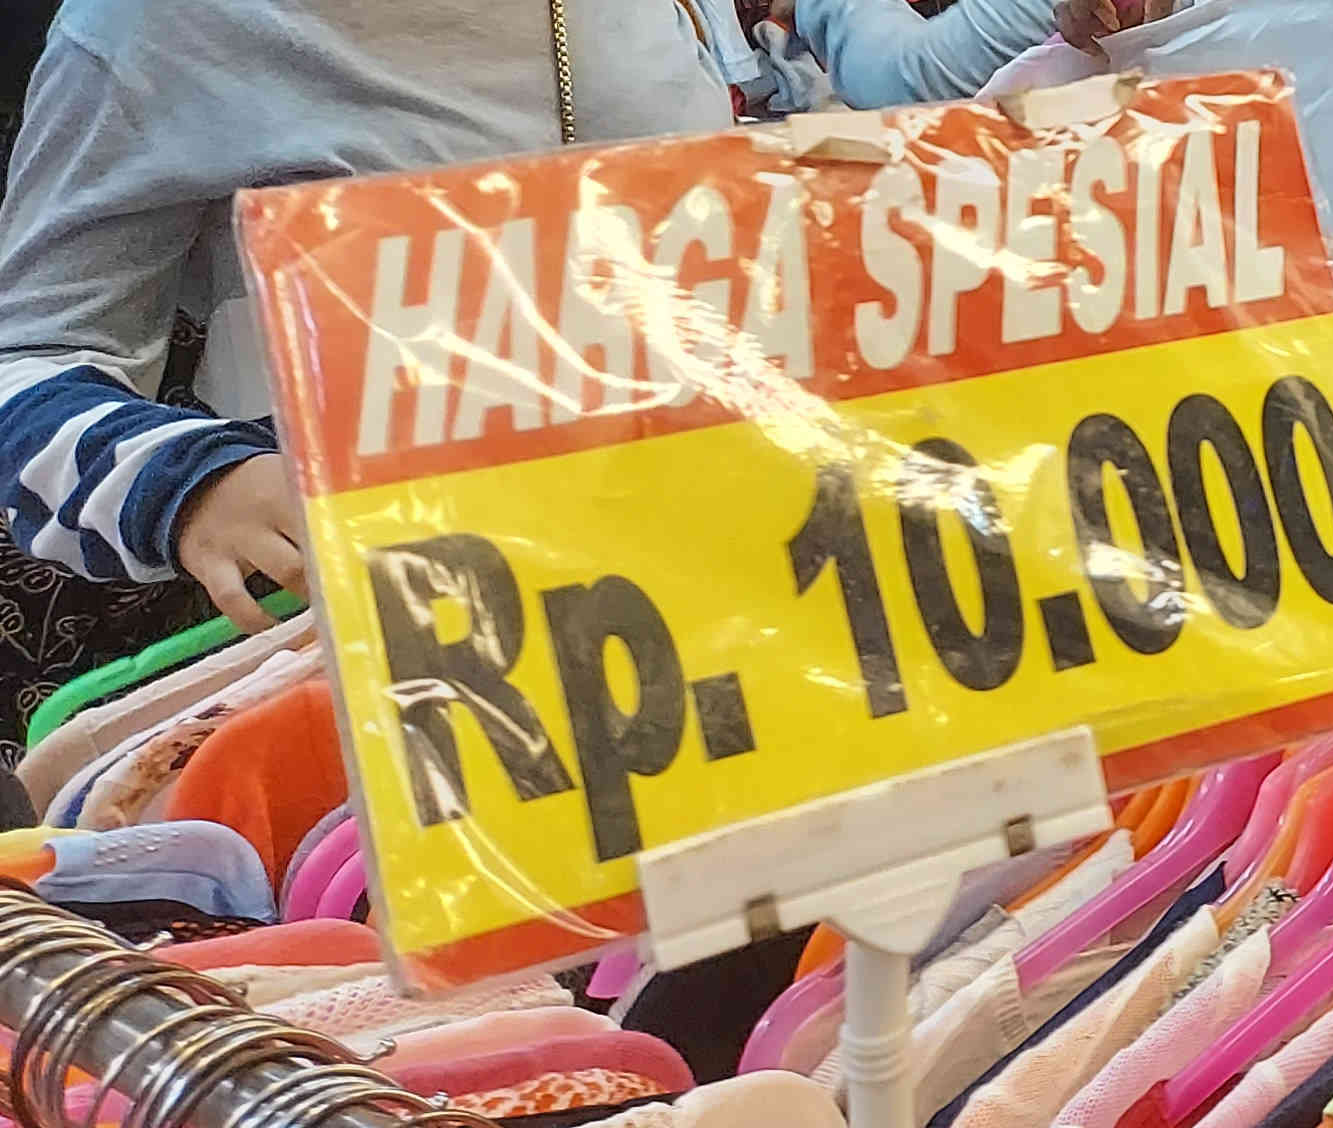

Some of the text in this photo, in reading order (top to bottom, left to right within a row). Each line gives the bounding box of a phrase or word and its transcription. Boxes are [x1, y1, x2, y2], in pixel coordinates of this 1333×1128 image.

[356, 120, 1286, 457] HARGA SPESIAL
[366, 532, 758, 863] Rp.
